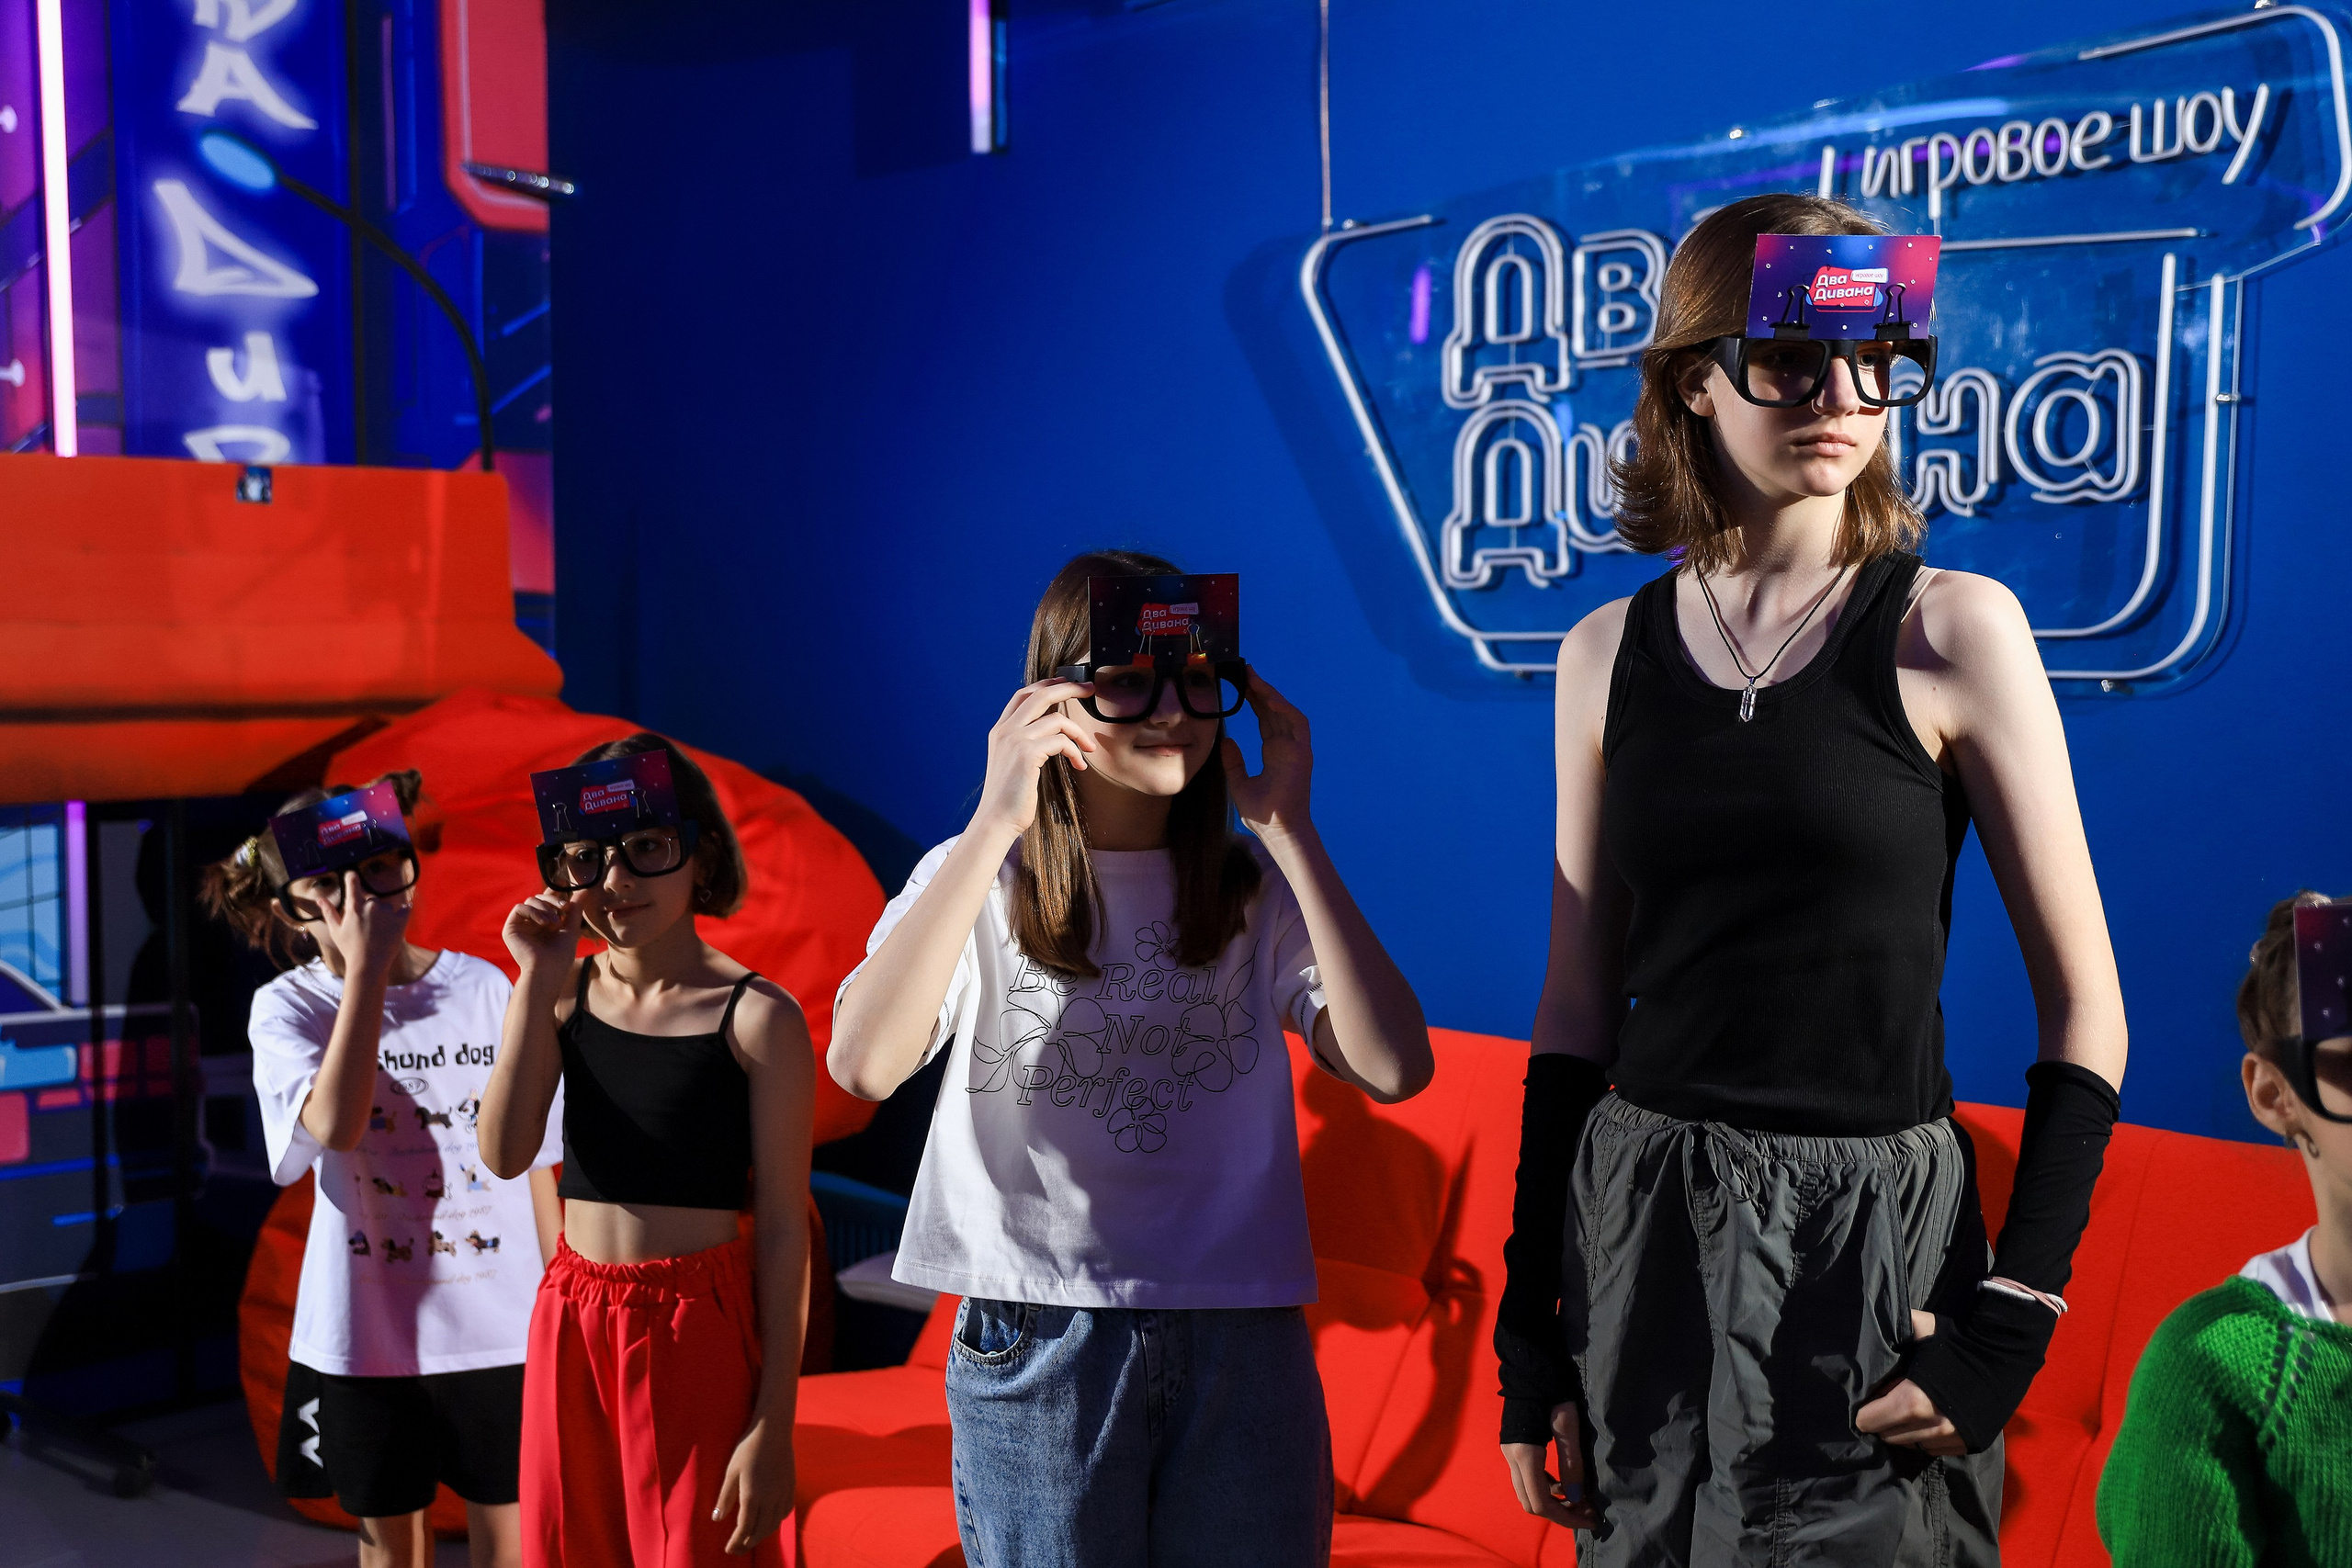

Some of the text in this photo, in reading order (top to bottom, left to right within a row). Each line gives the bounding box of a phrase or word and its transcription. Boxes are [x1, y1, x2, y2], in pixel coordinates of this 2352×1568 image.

[1860, 83, 2269, 220] игровое шоу
[1815, 274, 1848, 288] Два
[1813, 286, 1874, 302] Дивана
[1442, 347, 2142, 589] Дина
[1142, 609, 1167, 620] Два
[1142, 617, 1189, 632] Дивана
[582, 790, 605, 802] Два
[584, 794, 628, 811] Дивана
[1009, 953, 1218, 1005] Be Real
[1098, 1013, 1191, 1056] Not
[455, 1043, 495, 1067] dog
[1017, 1065, 1195, 1118] Perfect
